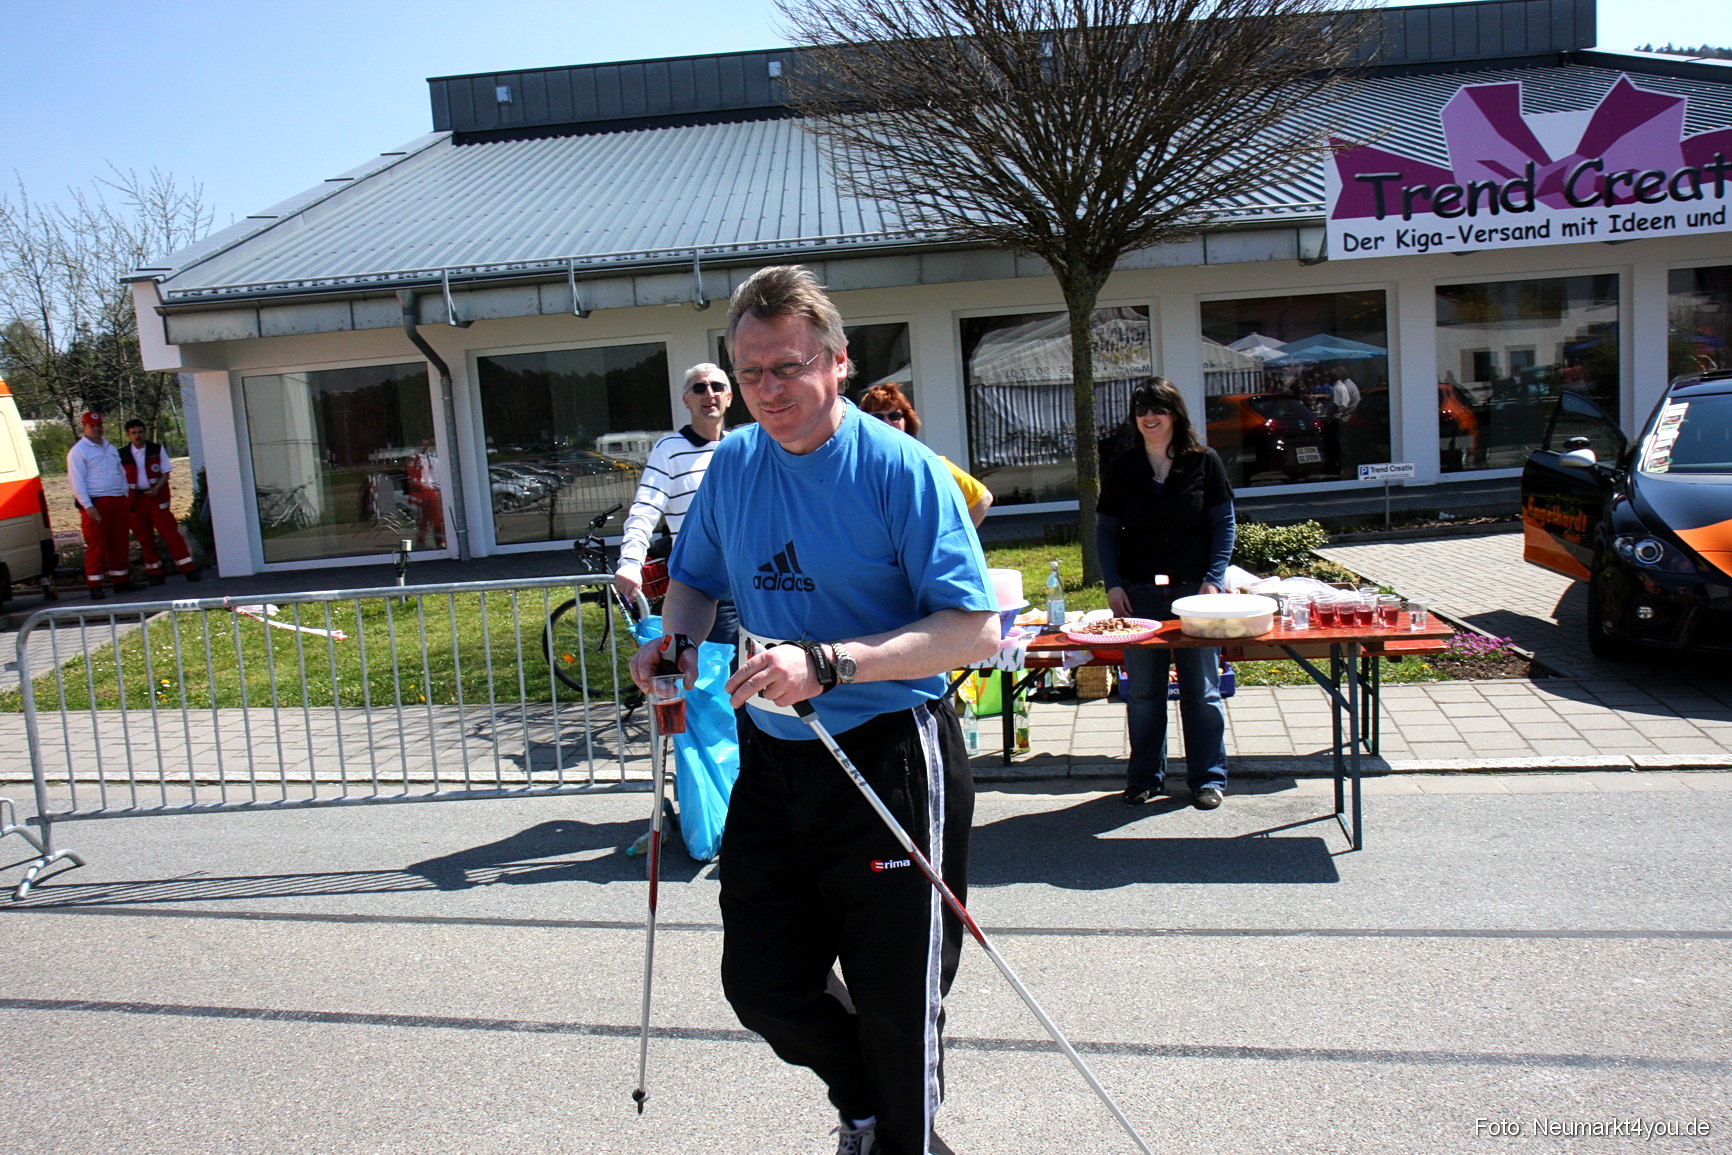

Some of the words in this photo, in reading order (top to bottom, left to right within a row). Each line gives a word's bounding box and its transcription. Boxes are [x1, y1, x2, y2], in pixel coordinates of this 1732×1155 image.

[1354, 160, 1536, 222] Trend
[1564, 152, 1732, 208] Creat
[1343, 232, 1385, 252] Der
[1396, 218, 1550, 253] Kiga-Versand
[1562, 216, 1598, 237] mit
[1608, 212, 1676, 233] Ideen
[1687, 205, 1726, 228] und
[1370, 465, 1388, 473] Trend
[1390, 464, 1413, 472] Creativ
[753, 572, 816, 592] adidas
[834, 748, 867, 787] LEKI
